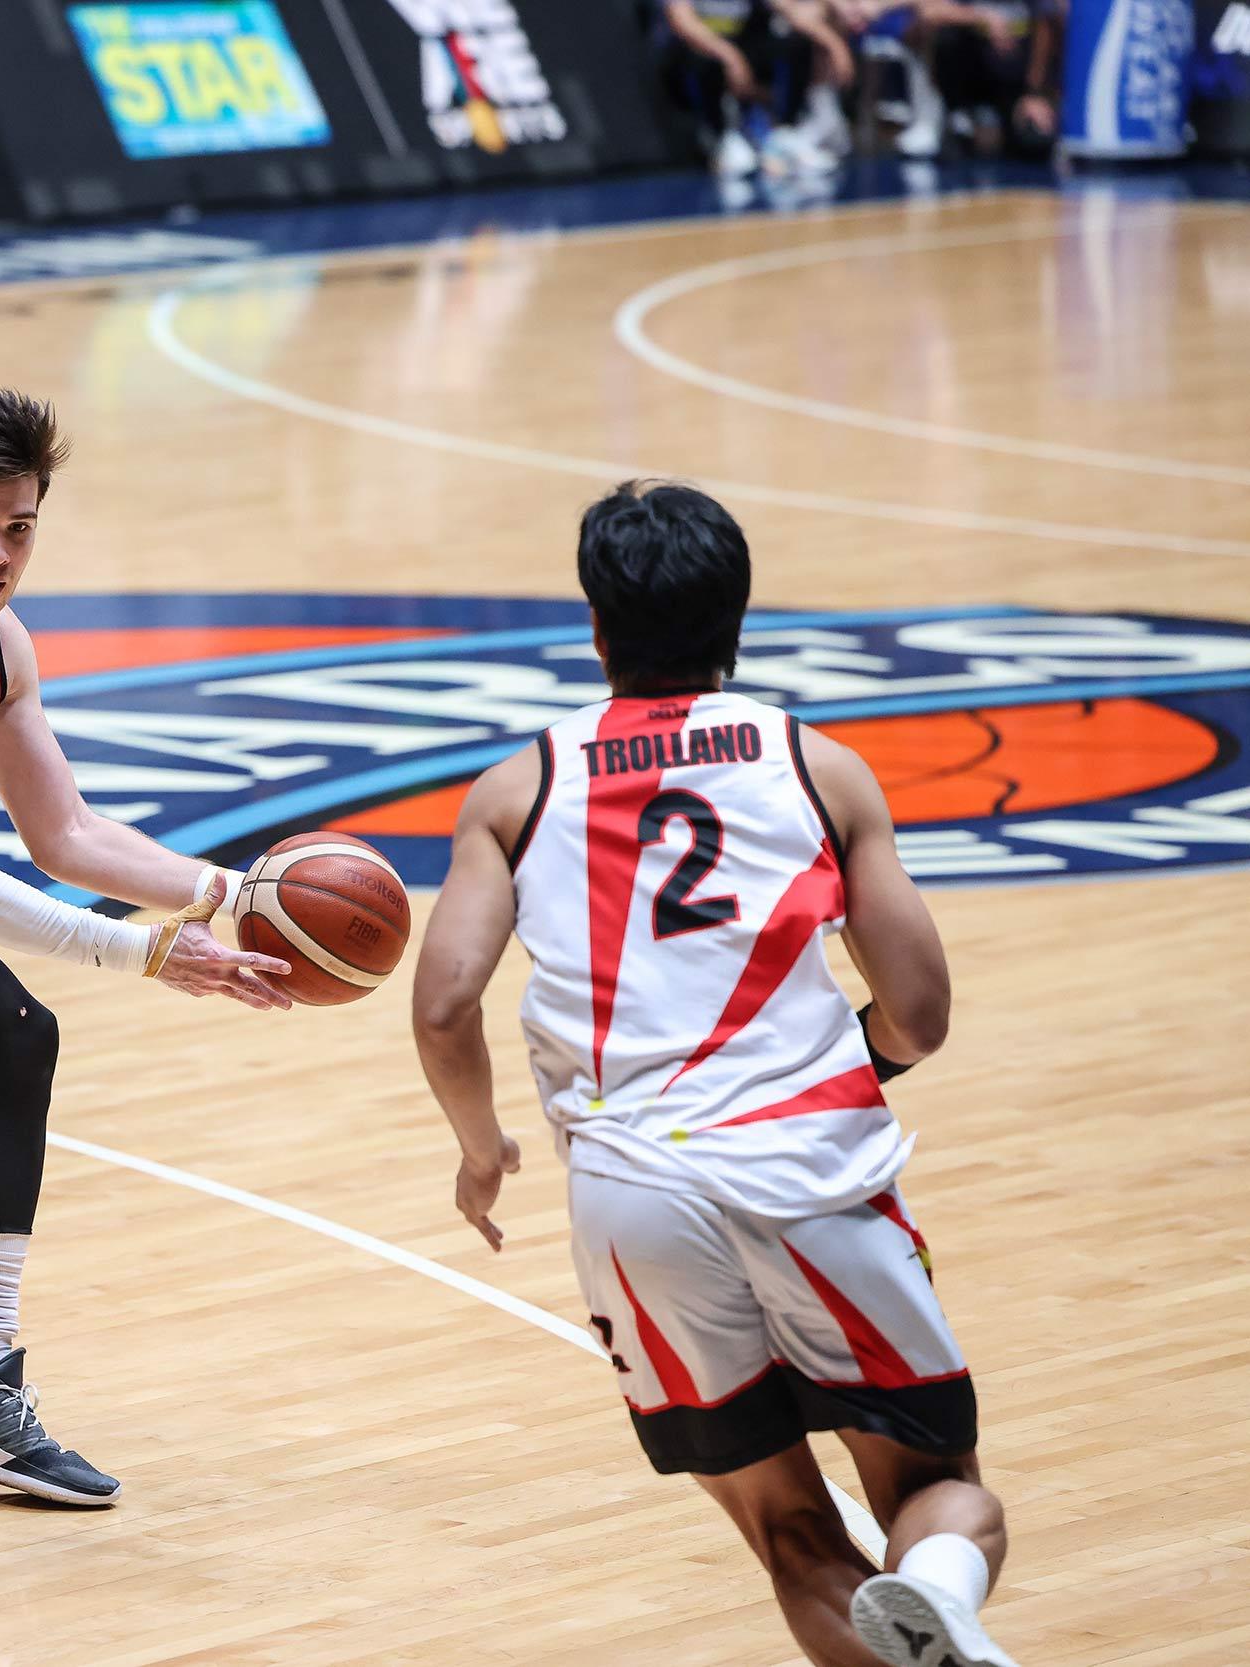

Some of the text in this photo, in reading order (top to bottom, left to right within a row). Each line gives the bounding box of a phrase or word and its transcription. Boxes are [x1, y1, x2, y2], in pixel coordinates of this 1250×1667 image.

[98, 34, 302, 125] STAR
[580, 722, 762, 777] TROLLANO
[344, 869, 406, 913] molten
[637, 787, 741, 941] 2
[347, 915, 382, 945] FIBA
